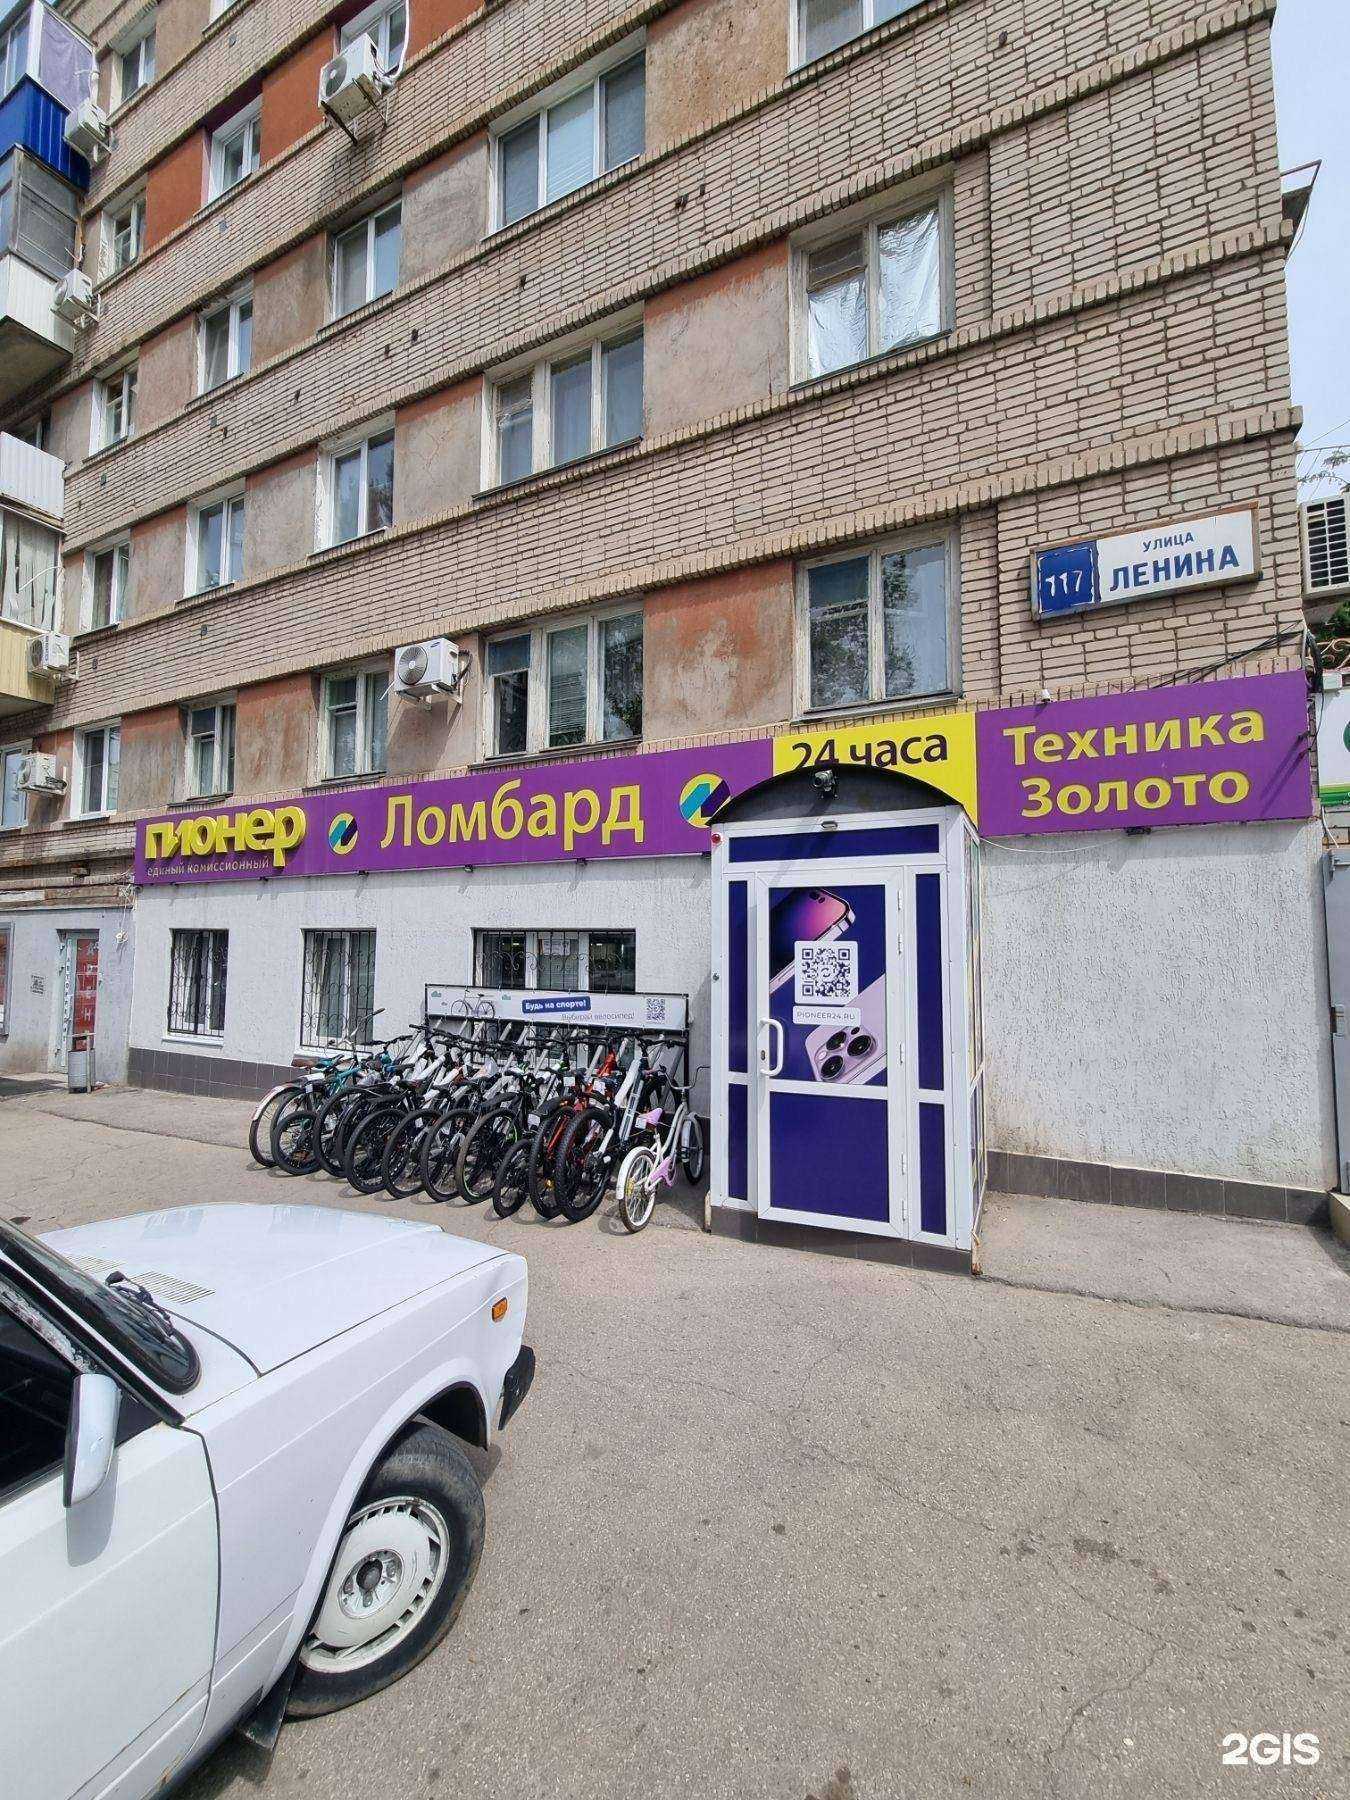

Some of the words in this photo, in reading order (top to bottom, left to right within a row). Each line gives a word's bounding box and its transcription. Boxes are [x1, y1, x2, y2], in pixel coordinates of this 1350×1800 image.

[1143, 532, 1195, 552] УЛИЦА
[1045, 570, 1083, 598] 117
[1109, 544, 1240, 593] ЛЕНИНА
[792, 739, 840, 770] 24
[849, 733, 948, 768] часа
[1002, 709, 1265, 766] Техника
[1020, 770, 1251, 818] Золото
[380, 778, 645, 851] Ломбард
[147, 861, 188, 878] единый
[187, 855, 270, 874] комиссионный
[525, 1002, 544, 1011] Будь
[545, 1001, 555, 1009] на
[796, 1011, 856, 1020] PIONEER24.RU
